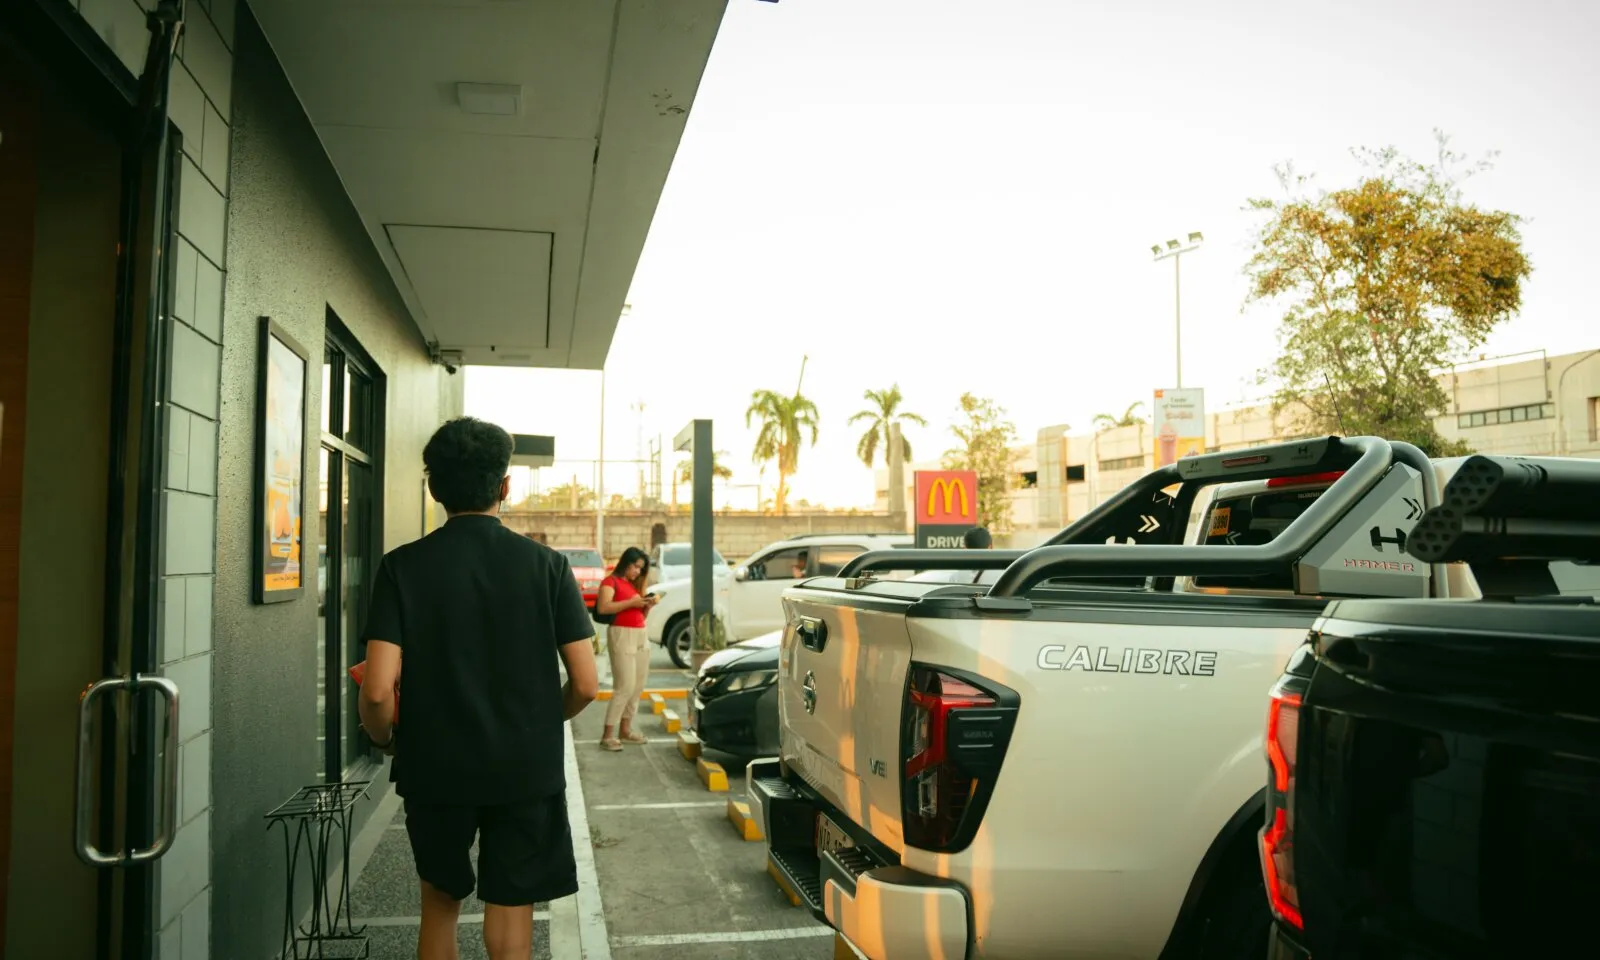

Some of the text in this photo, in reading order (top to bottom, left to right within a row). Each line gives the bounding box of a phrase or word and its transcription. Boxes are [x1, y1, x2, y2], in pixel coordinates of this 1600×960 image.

[926, 535, 966, 549] DRIVE
[1343, 558, 1415, 573] HAMER
[1035, 643, 1218, 677] CALIBRE
